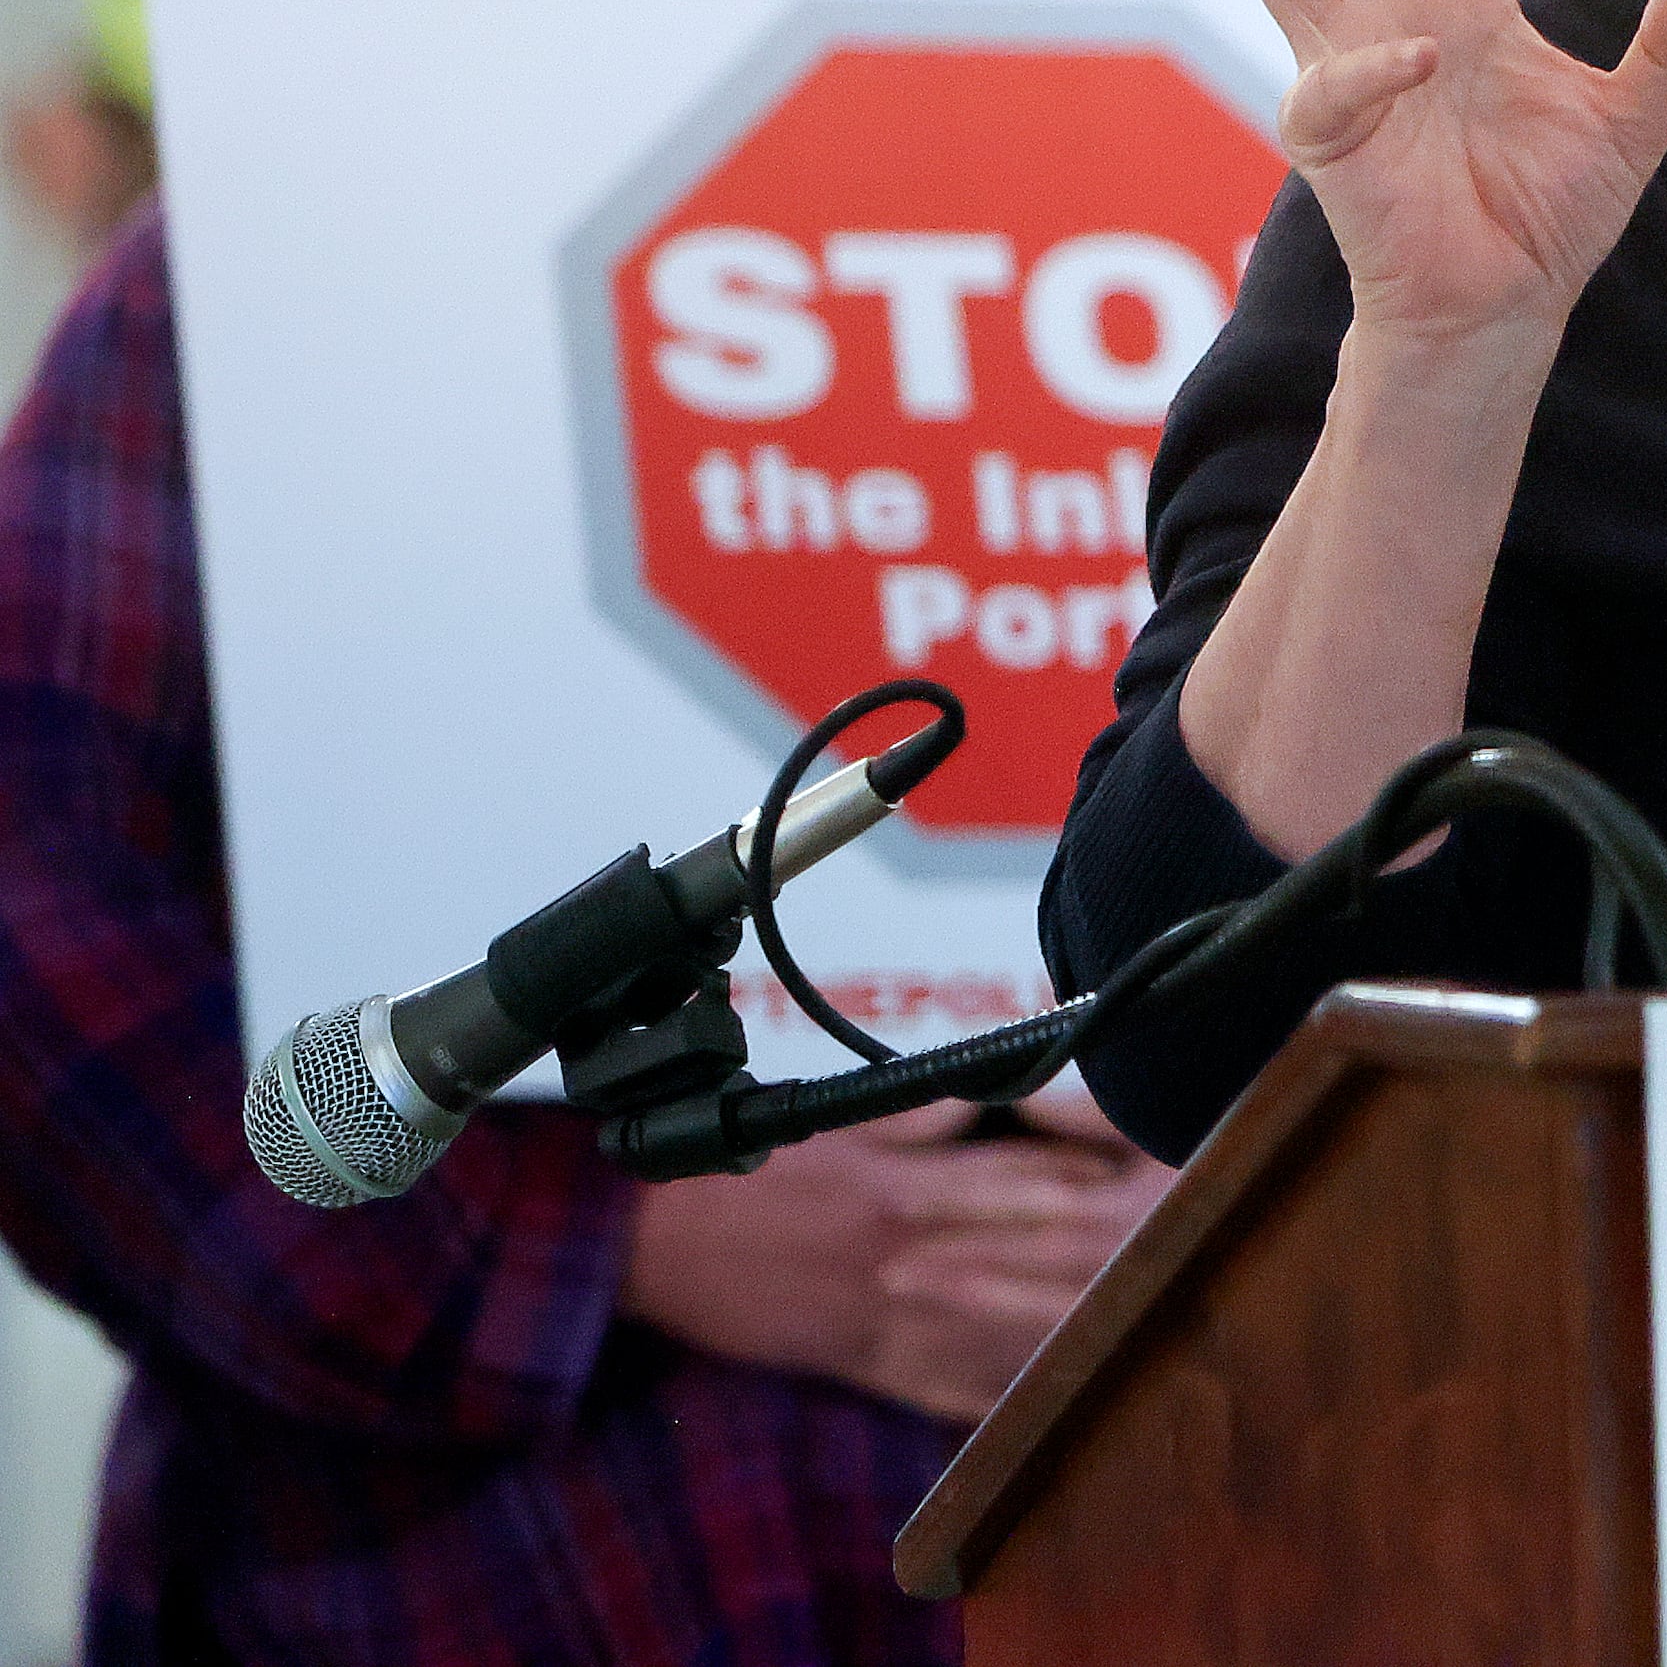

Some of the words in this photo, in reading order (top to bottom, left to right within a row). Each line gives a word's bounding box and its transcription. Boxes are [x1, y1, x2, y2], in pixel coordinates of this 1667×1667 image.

[645, 226, 1258, 424] STO
[690, 446, 932, 556] the
[876, 564, 1158, 679] Por
